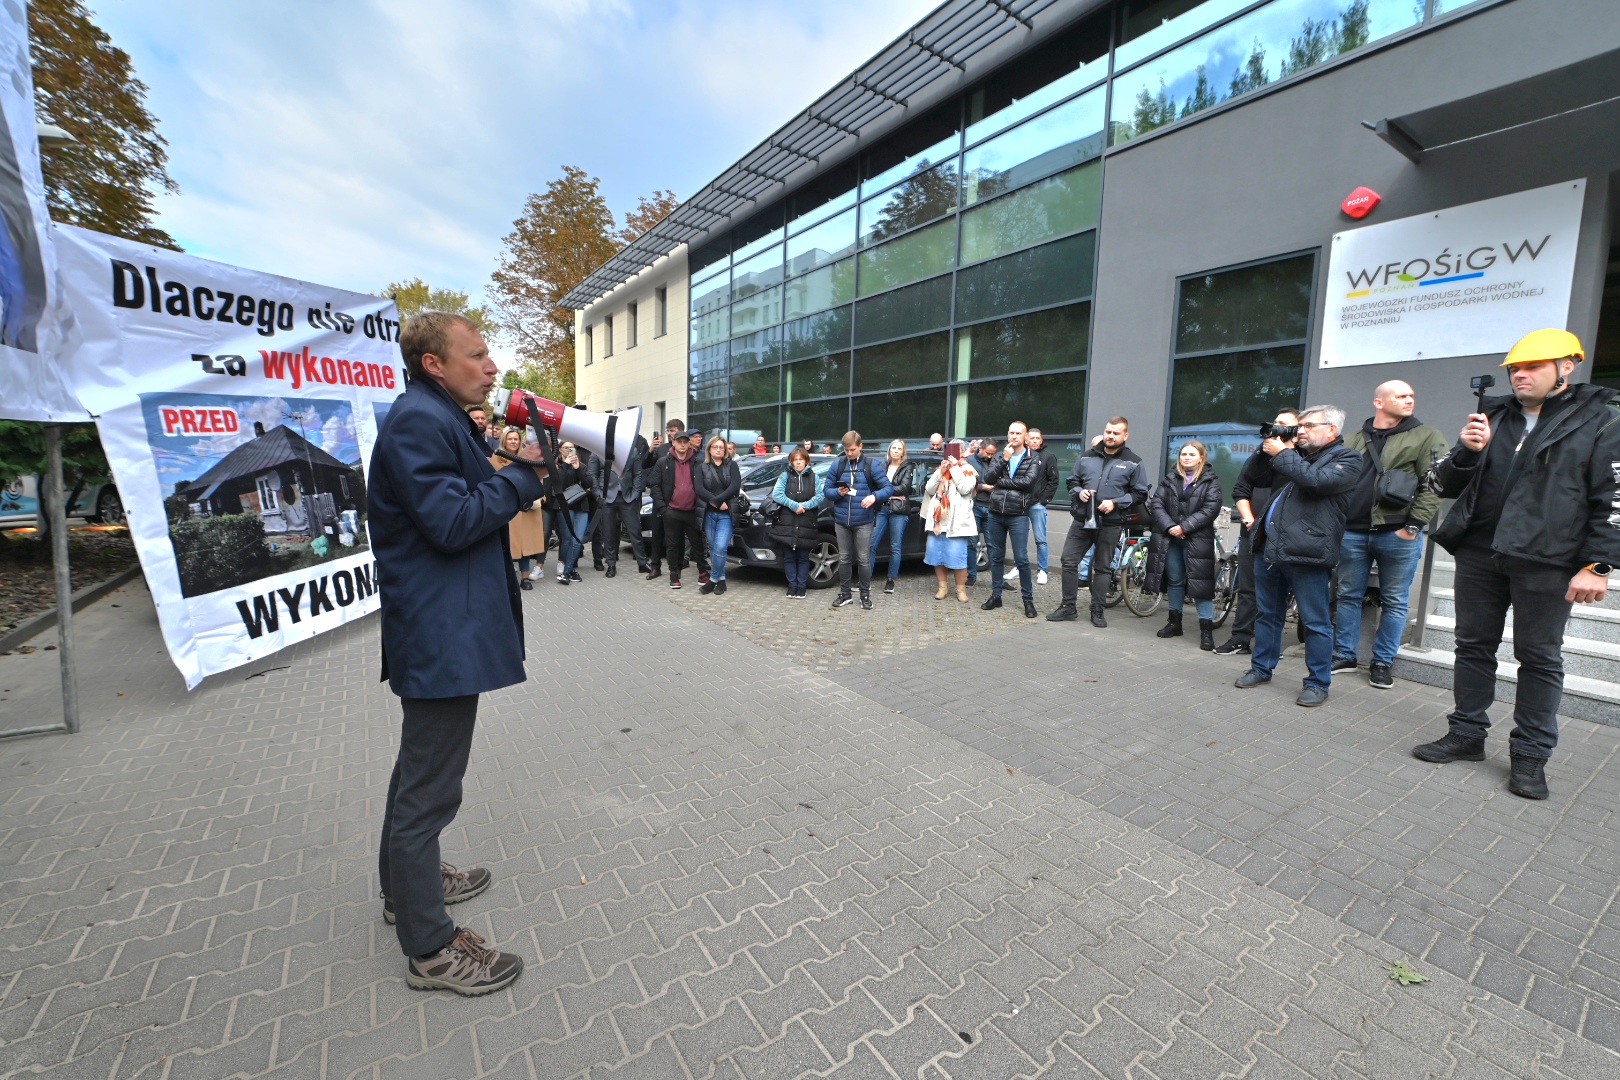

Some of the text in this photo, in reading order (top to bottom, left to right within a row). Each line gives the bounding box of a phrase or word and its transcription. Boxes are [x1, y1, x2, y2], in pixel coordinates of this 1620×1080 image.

[1347, 194, 1369, 206] POŻAR
[110, 258, 294, 337] Dlaczego
[307, 302, 355, 335] nie
[1341, 280, 1525, 313] WOJEWÓDZKI FUNDUSZ OCHRONY
[1341, 306, 1407, 321] ŚRODOWISKA
[1414, 296, 1488, 312] GOSPODARKI
[1491, 287, 1545, 301] WODNEJ
[1340, 315, 1402, 330] W POZNANIU
[191, 353, 246, 376] za
[258, 346, 395, 389] wykonane
[162, 408, 239, 434] PRZED
